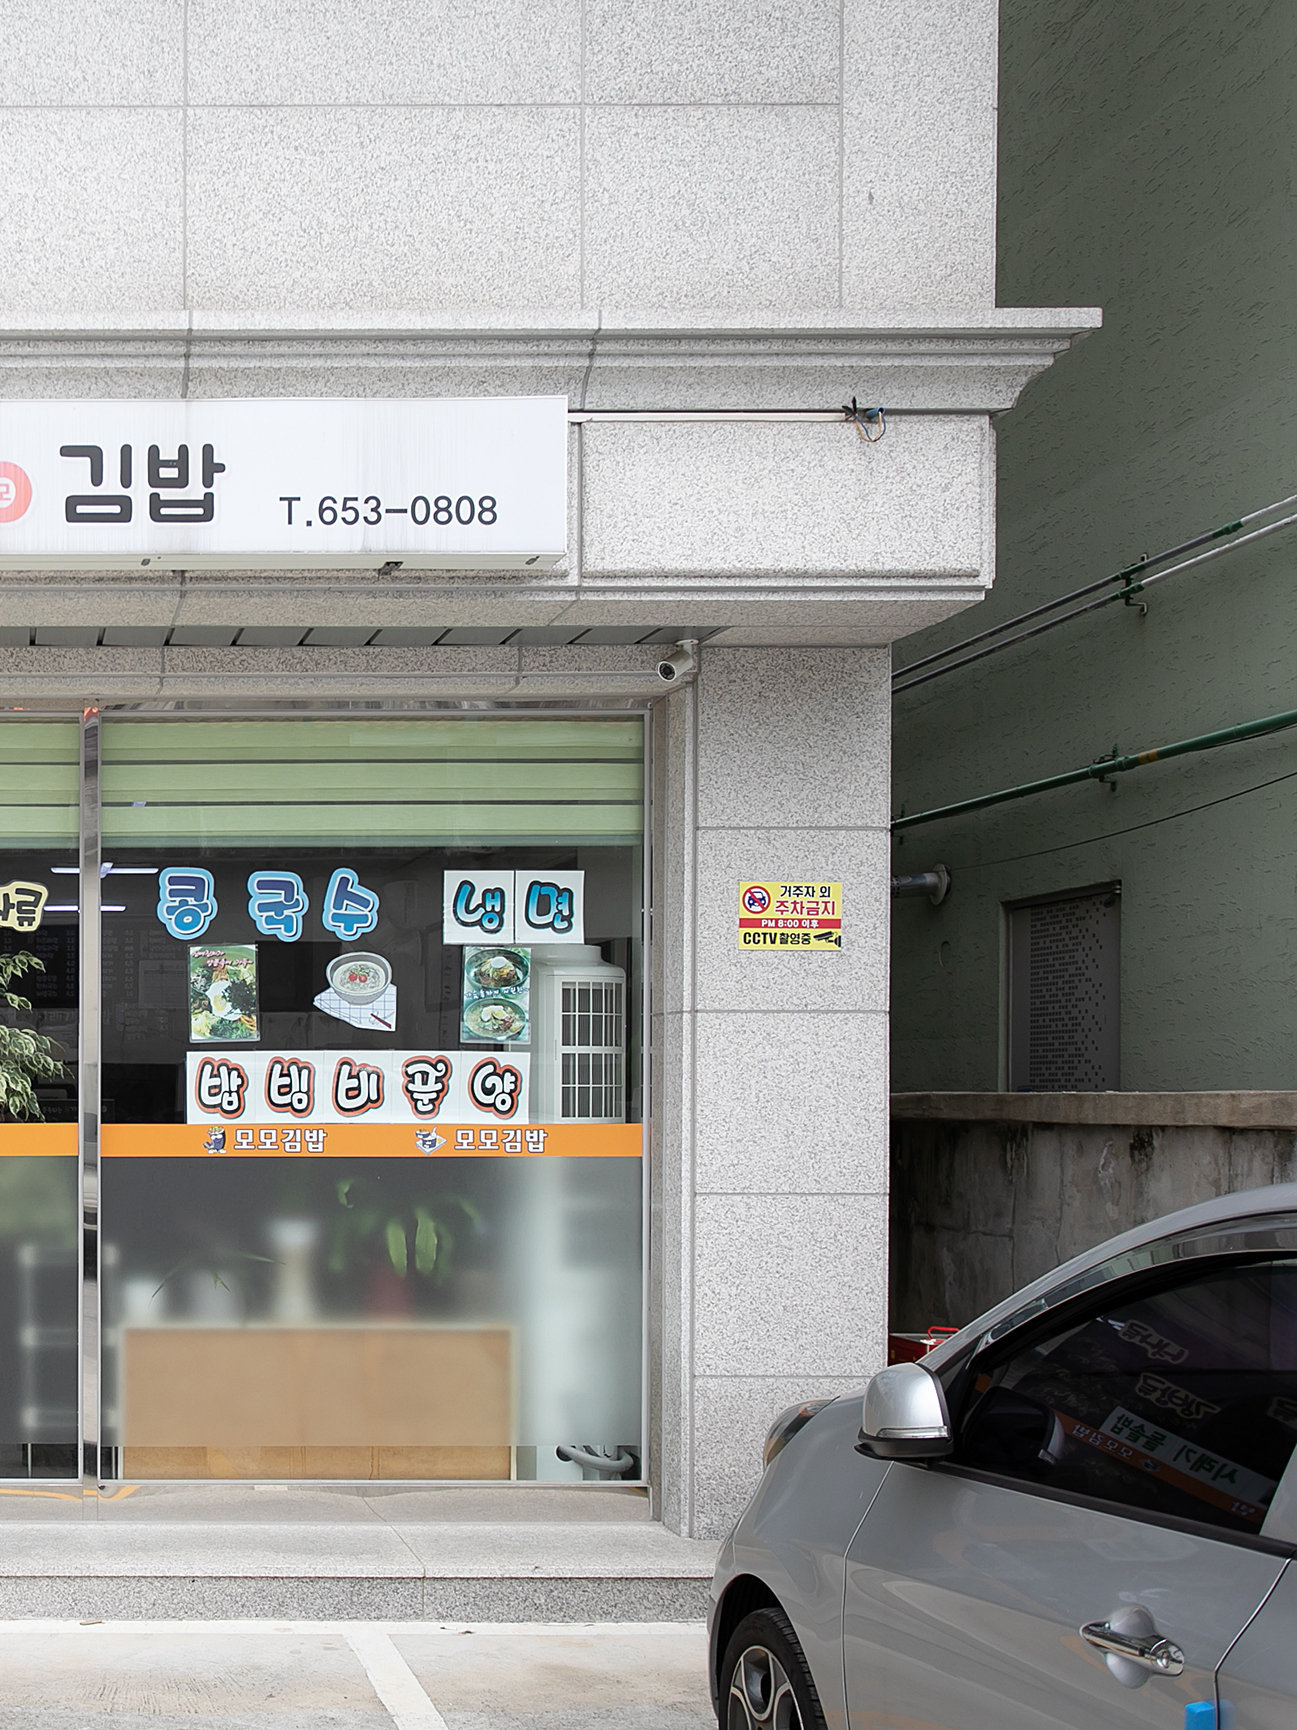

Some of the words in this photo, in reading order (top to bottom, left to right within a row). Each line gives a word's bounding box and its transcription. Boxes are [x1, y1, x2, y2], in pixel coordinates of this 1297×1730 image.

[59, 443, 226, 524] 김밥
[278, 495, 499, 527] T.653-0808
[780, 885, 816, 898] 거주자
[819, 885, 831, 898] 외
[164, 873, 374, 935] 콩국수
[454, 880, 573, 933] 냉면
[775, 900, 836, 916] 주차금지
[761, 919, 775, 928] PM
[777, 919, 799, 928] 8:00
[801, 919, 819, 928] 이후
[743, 932, 778, 945] CCTV
[234, 1129, 328, 1153] 모모김밥
[454, 1129, 548, 1153] 모모김밥
